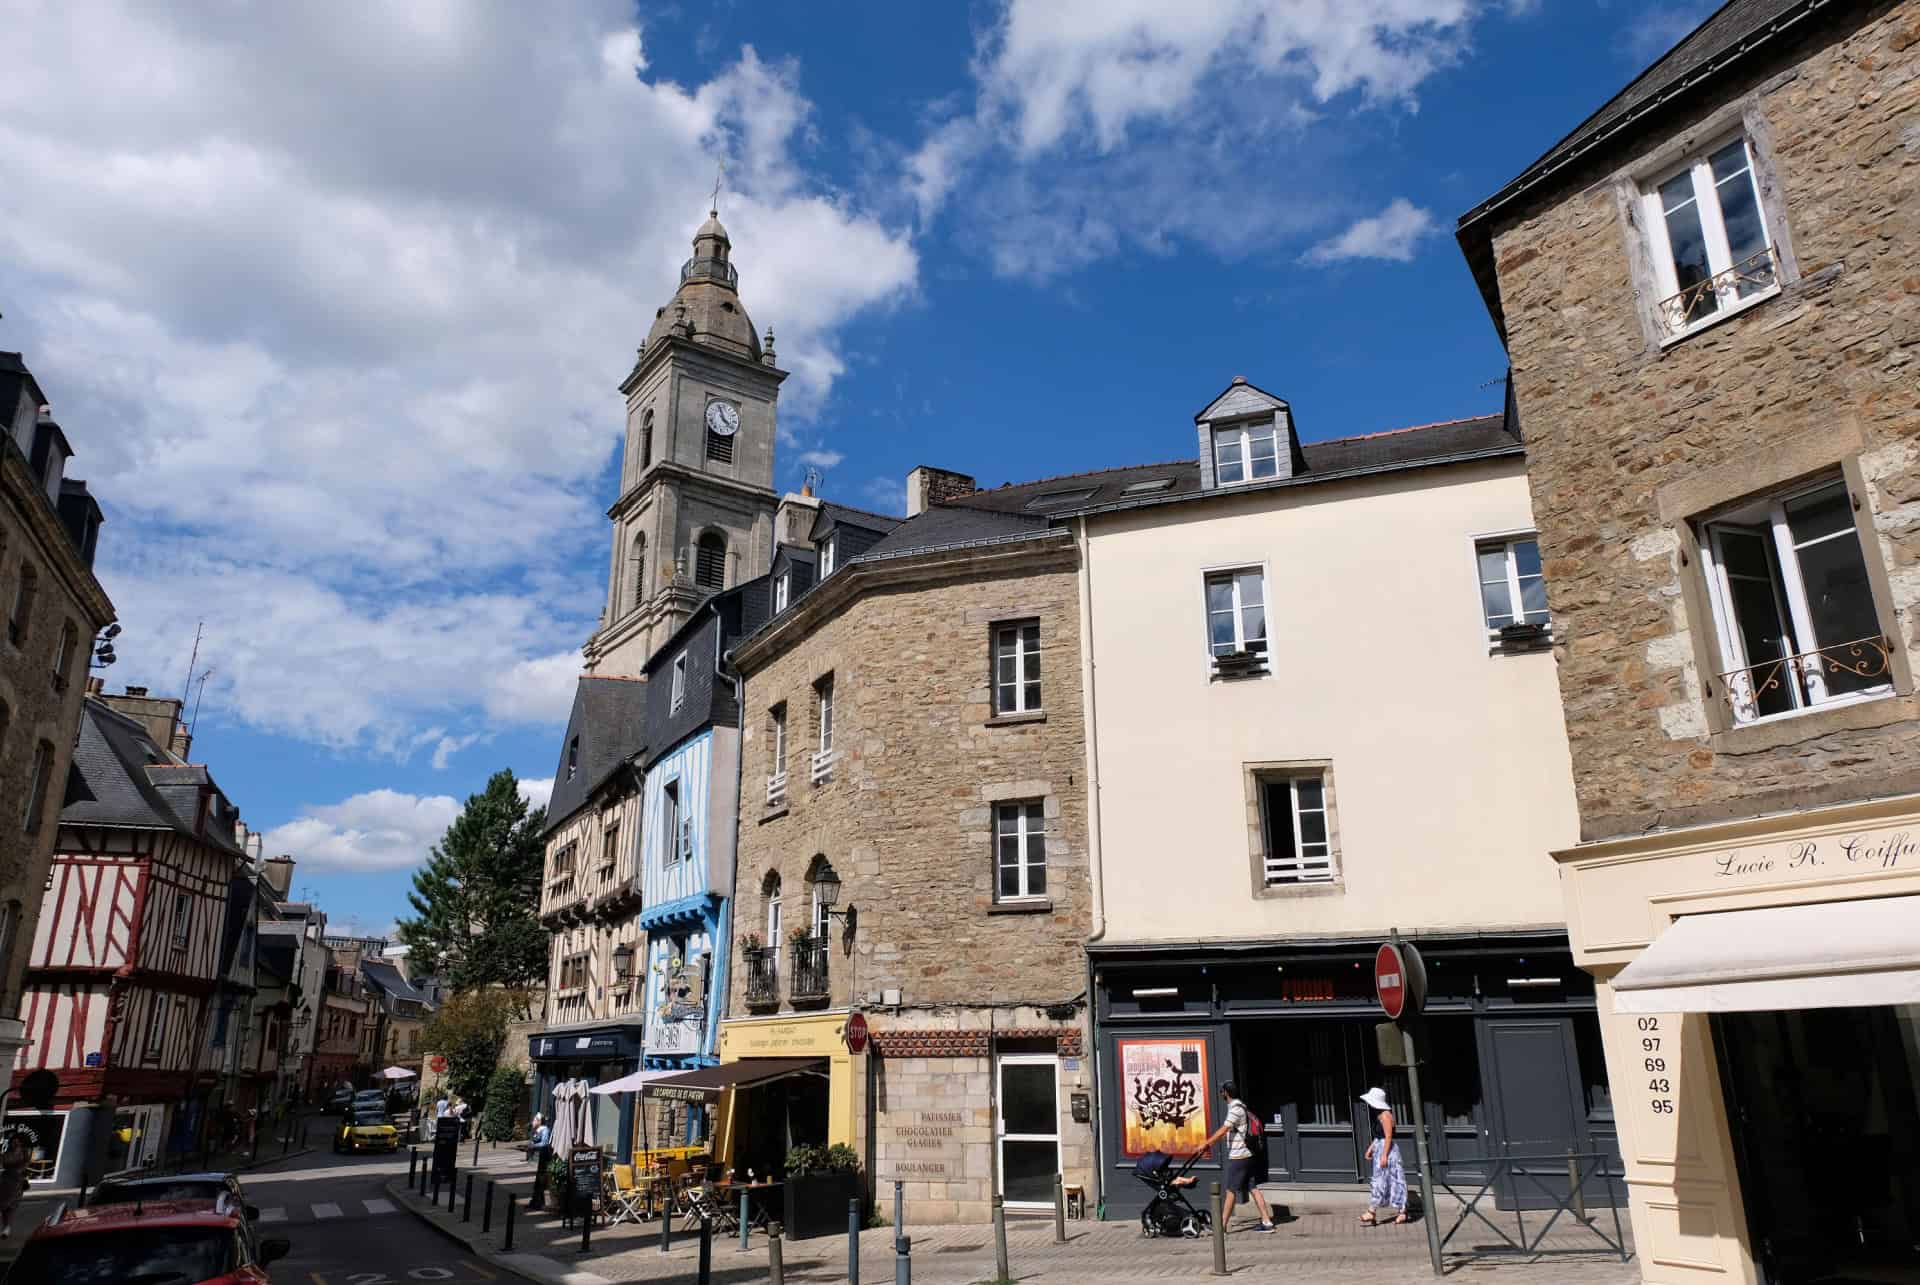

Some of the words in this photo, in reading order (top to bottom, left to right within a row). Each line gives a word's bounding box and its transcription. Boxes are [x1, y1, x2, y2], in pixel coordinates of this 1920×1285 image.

[1715, 852, 1775, 876] Lucie
[1789, 841, 1825, 868] R.
[1638, 1017, 1659, 1031] 02
[850, 1025, 866, 1039] STOP
[1642, 1038, 1661, 1051] 97
[1645, 1058, 1665, 1072] 69
[1649, 1079, 1670, 1093] 43
[1652, 1099, 1673, 1113] 95
[896, 1127, 952, 1136] CHOCOLATIER
[907, 1138, 942, 1147] GLACIER
[896, 1162, 944, 1172] BOULANGER
